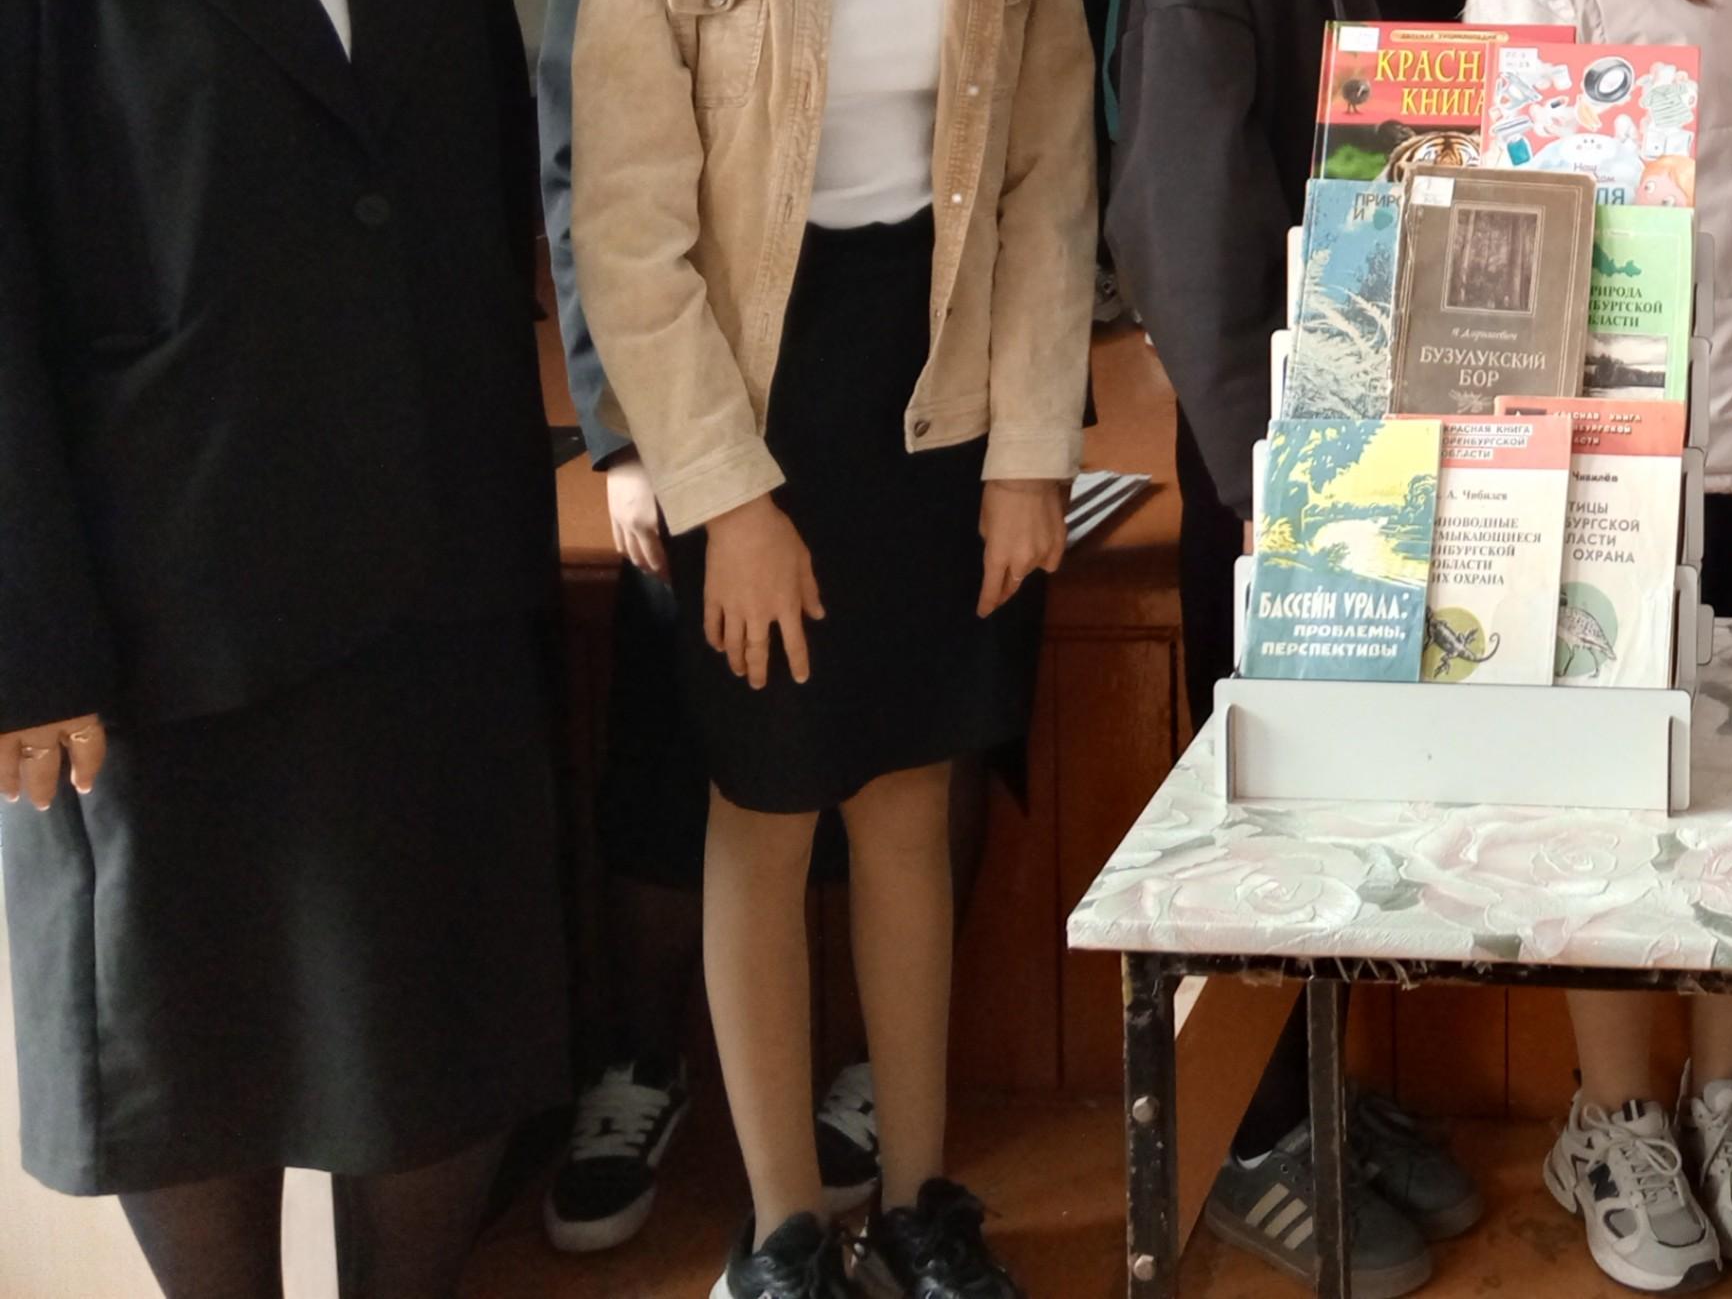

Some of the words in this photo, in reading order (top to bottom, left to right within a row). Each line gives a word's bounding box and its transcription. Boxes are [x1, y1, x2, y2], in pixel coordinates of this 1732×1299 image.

[1375, 48, 1485, 82] КРАСН
[1590, 285, 1642, 299] РИРОДА
[1588, 300, 1663, 314] БУРГСКОЙ
[1420, 345, 1546, 370] БУЗУЛУКСКИЙ
[1459, 368, 1500, 387] БОР
[1496, 425, 1531, 434] КНИГА
[1568, 500, 1608, 515] ТИЦЫ
[1565, 517, 1640, 532] БУРГСКОЙ
[1565, 532, 1617, 547] ЛАСТИ
[1573, 548, 1635, 563] ОХРАНА
[1453, 573, 1505, 585] ОХРАНА
[1259, 585, 1336, 618] БАССЕЙН
[1344, 592, 1409, 620] УРАЛА:
[1293, 623, 1406, 640] ПРОБЛЕМЫ,
[1261, 641, 1398, 657] ПЕРСПЕКТИВЫ
